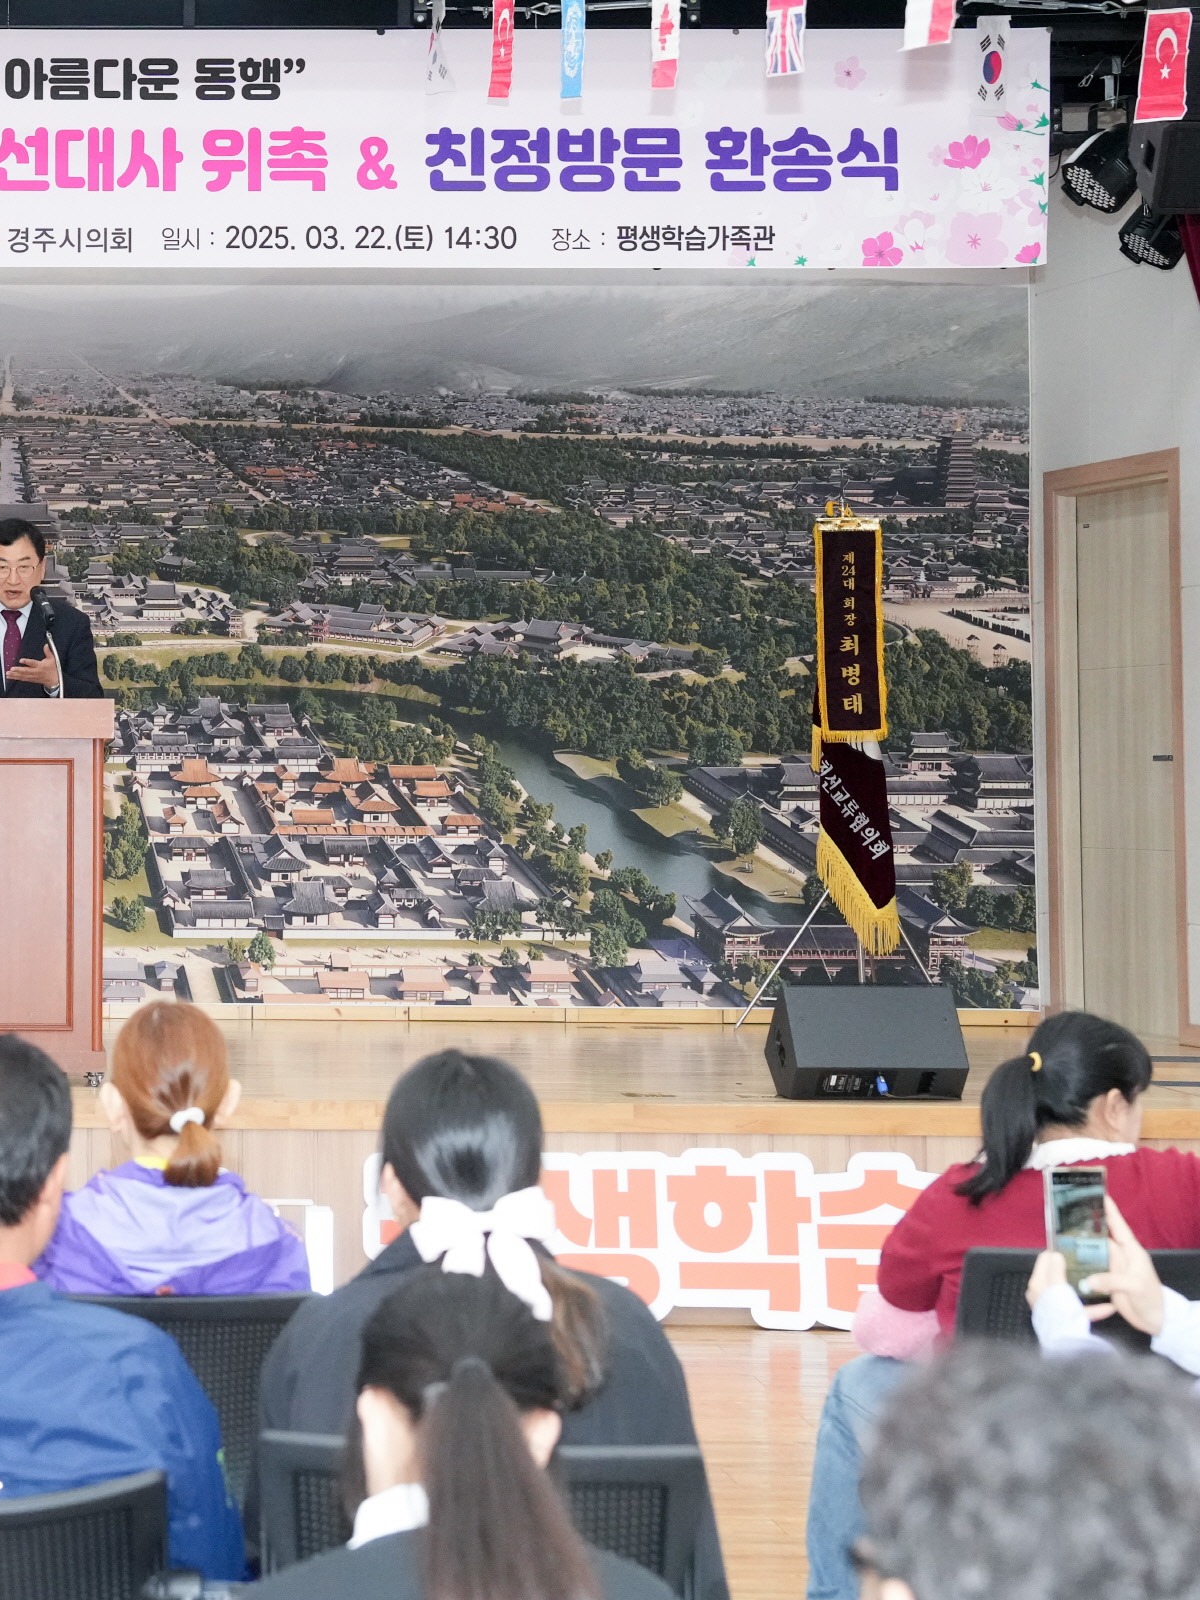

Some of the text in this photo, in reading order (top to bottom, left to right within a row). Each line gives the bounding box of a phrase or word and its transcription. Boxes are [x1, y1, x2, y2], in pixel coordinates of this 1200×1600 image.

[4, 57, 180, 101] 아름다운
[201, 125, 329, 193] 위촉
[356, 136, 398, 191] &
[424, 126, 684, 193] 친정방문
[704, 125, 899, 193] 환송식
[7, 226, 132, 254] 경주시의회
[225, 225, 296, 250] 2025.
[305, 225, 345, 250] 03.
[354, 224, 434, 251] 22.(토)
[444, 225, 518, 250] 14:30
[616, 225, 776, 252] 평생학습가족관
[843, 596, 857, 627] 회장
